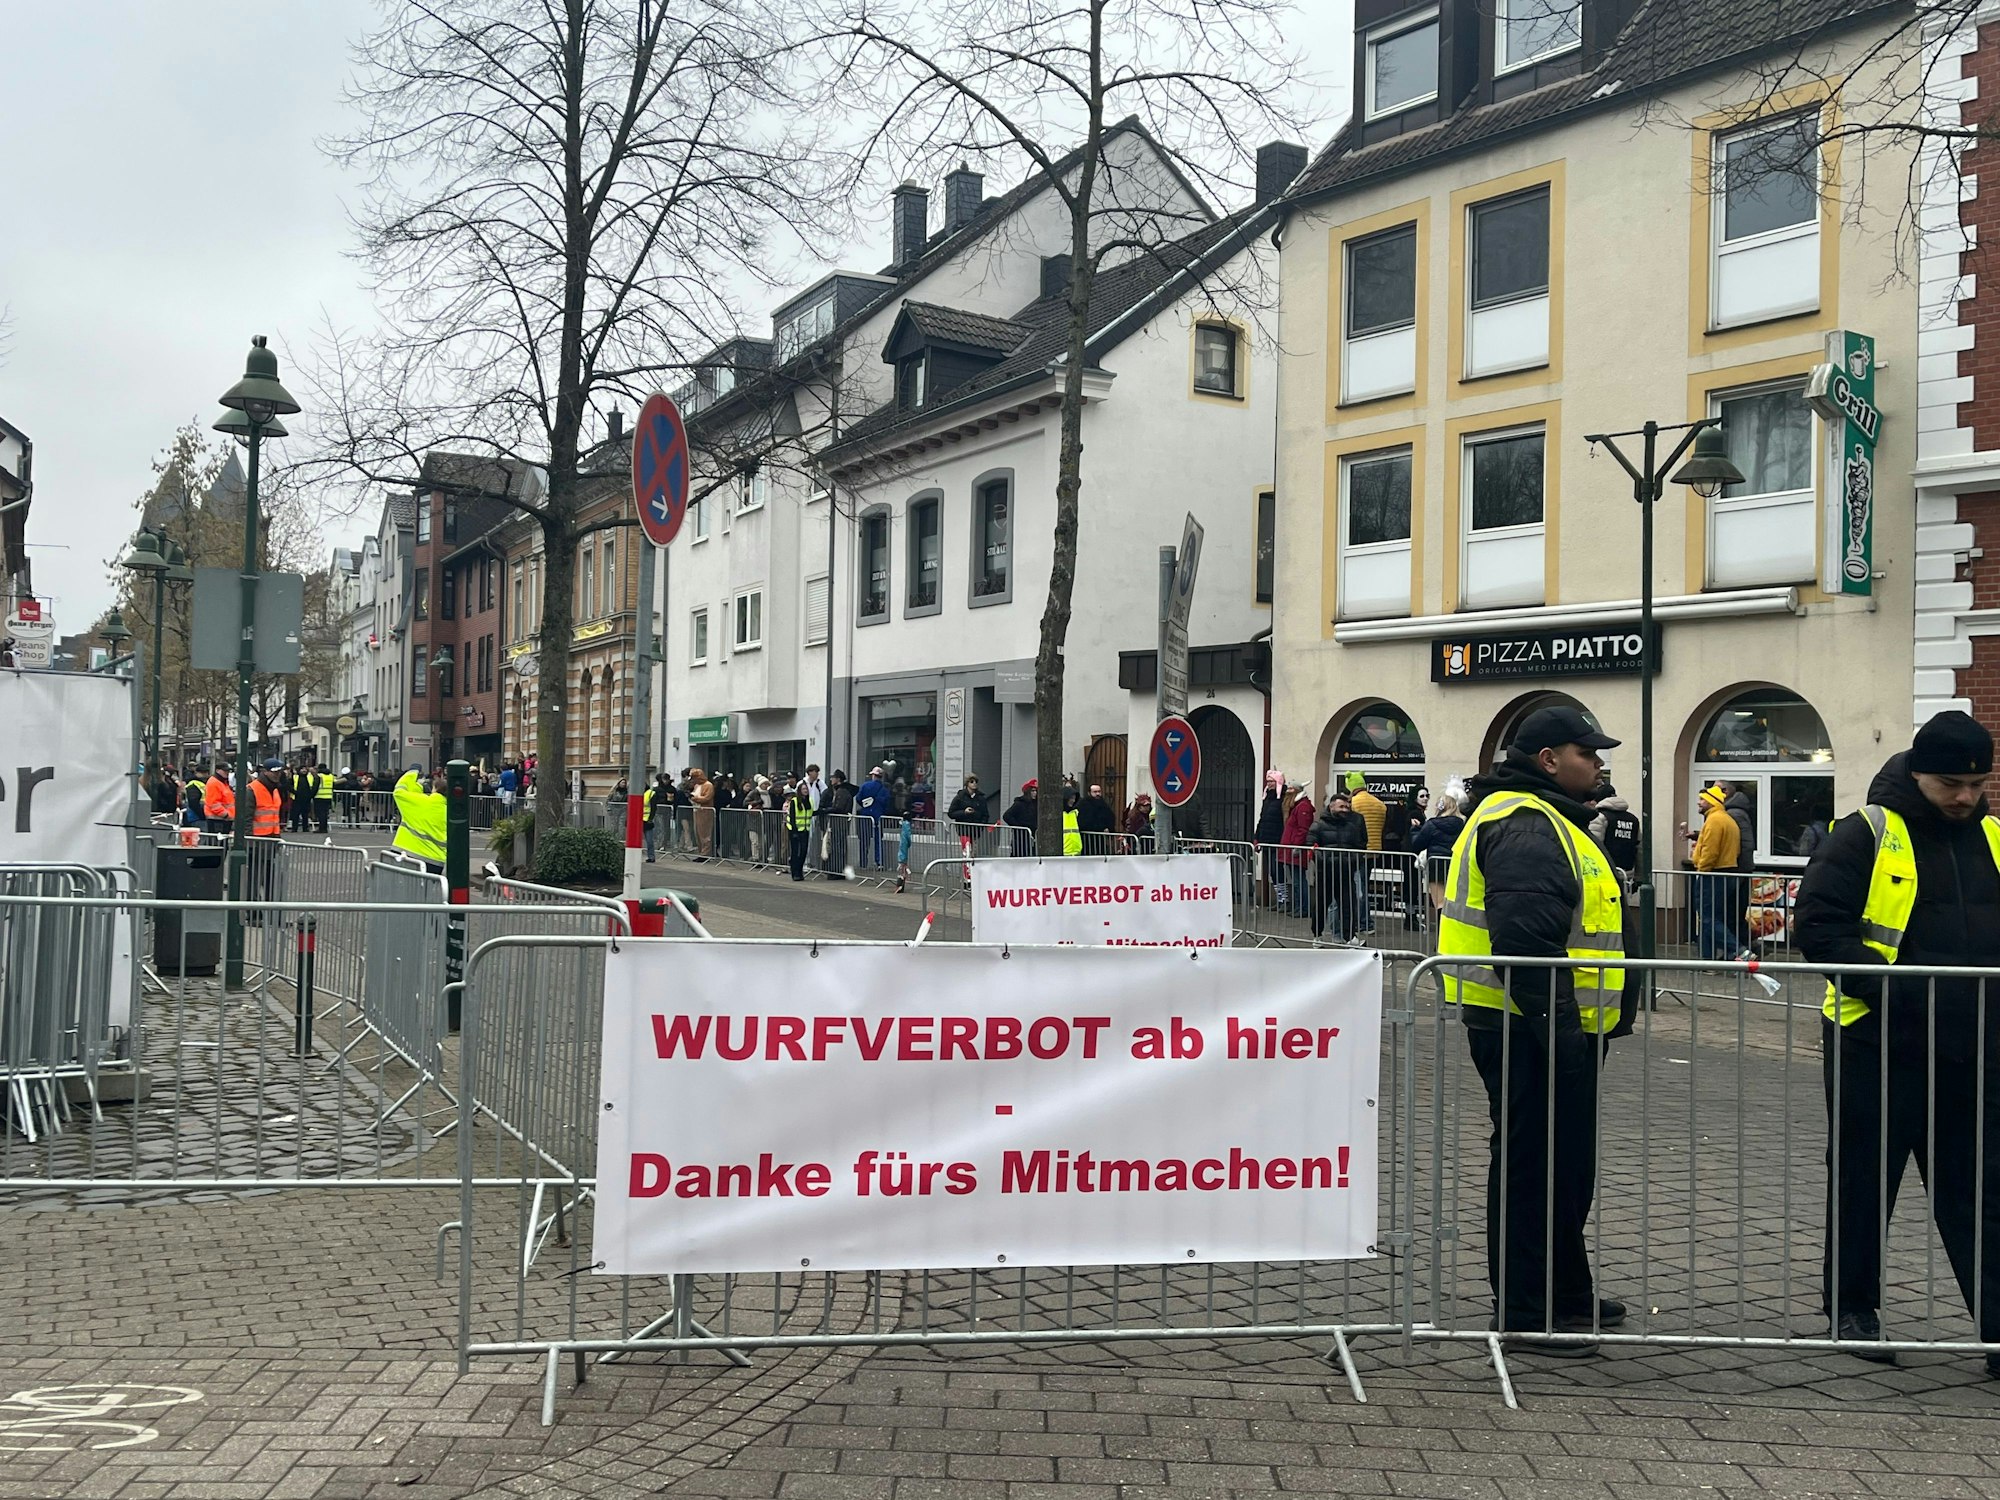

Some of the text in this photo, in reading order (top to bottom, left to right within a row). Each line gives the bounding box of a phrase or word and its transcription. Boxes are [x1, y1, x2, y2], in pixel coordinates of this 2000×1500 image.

[1833, 377, 1877, 437] Grill
[15, 641, 46, 650] Jeans
[18, 650, 45, 660] Shop
[1478, 634, 1643, 664] PIZZA PIATTO
[1478, 659, 1643, 675] ORIGINAL MEDITERRANEAN FOOD
[1366, 783, 1388, 793] IZZA
[0, 767, 54, 833] r
[1614, 828, 1632, 840] POLICE
[1616, 820, 1633, 831] SWAT
[987, 883, 1218, 909] WURFVERBOT ab hier
[651, 1014, 1341, 1062] WURFVERBOT ab hier
[628, 1145, 1352, 1199] Danke fürs Mitmachen!
